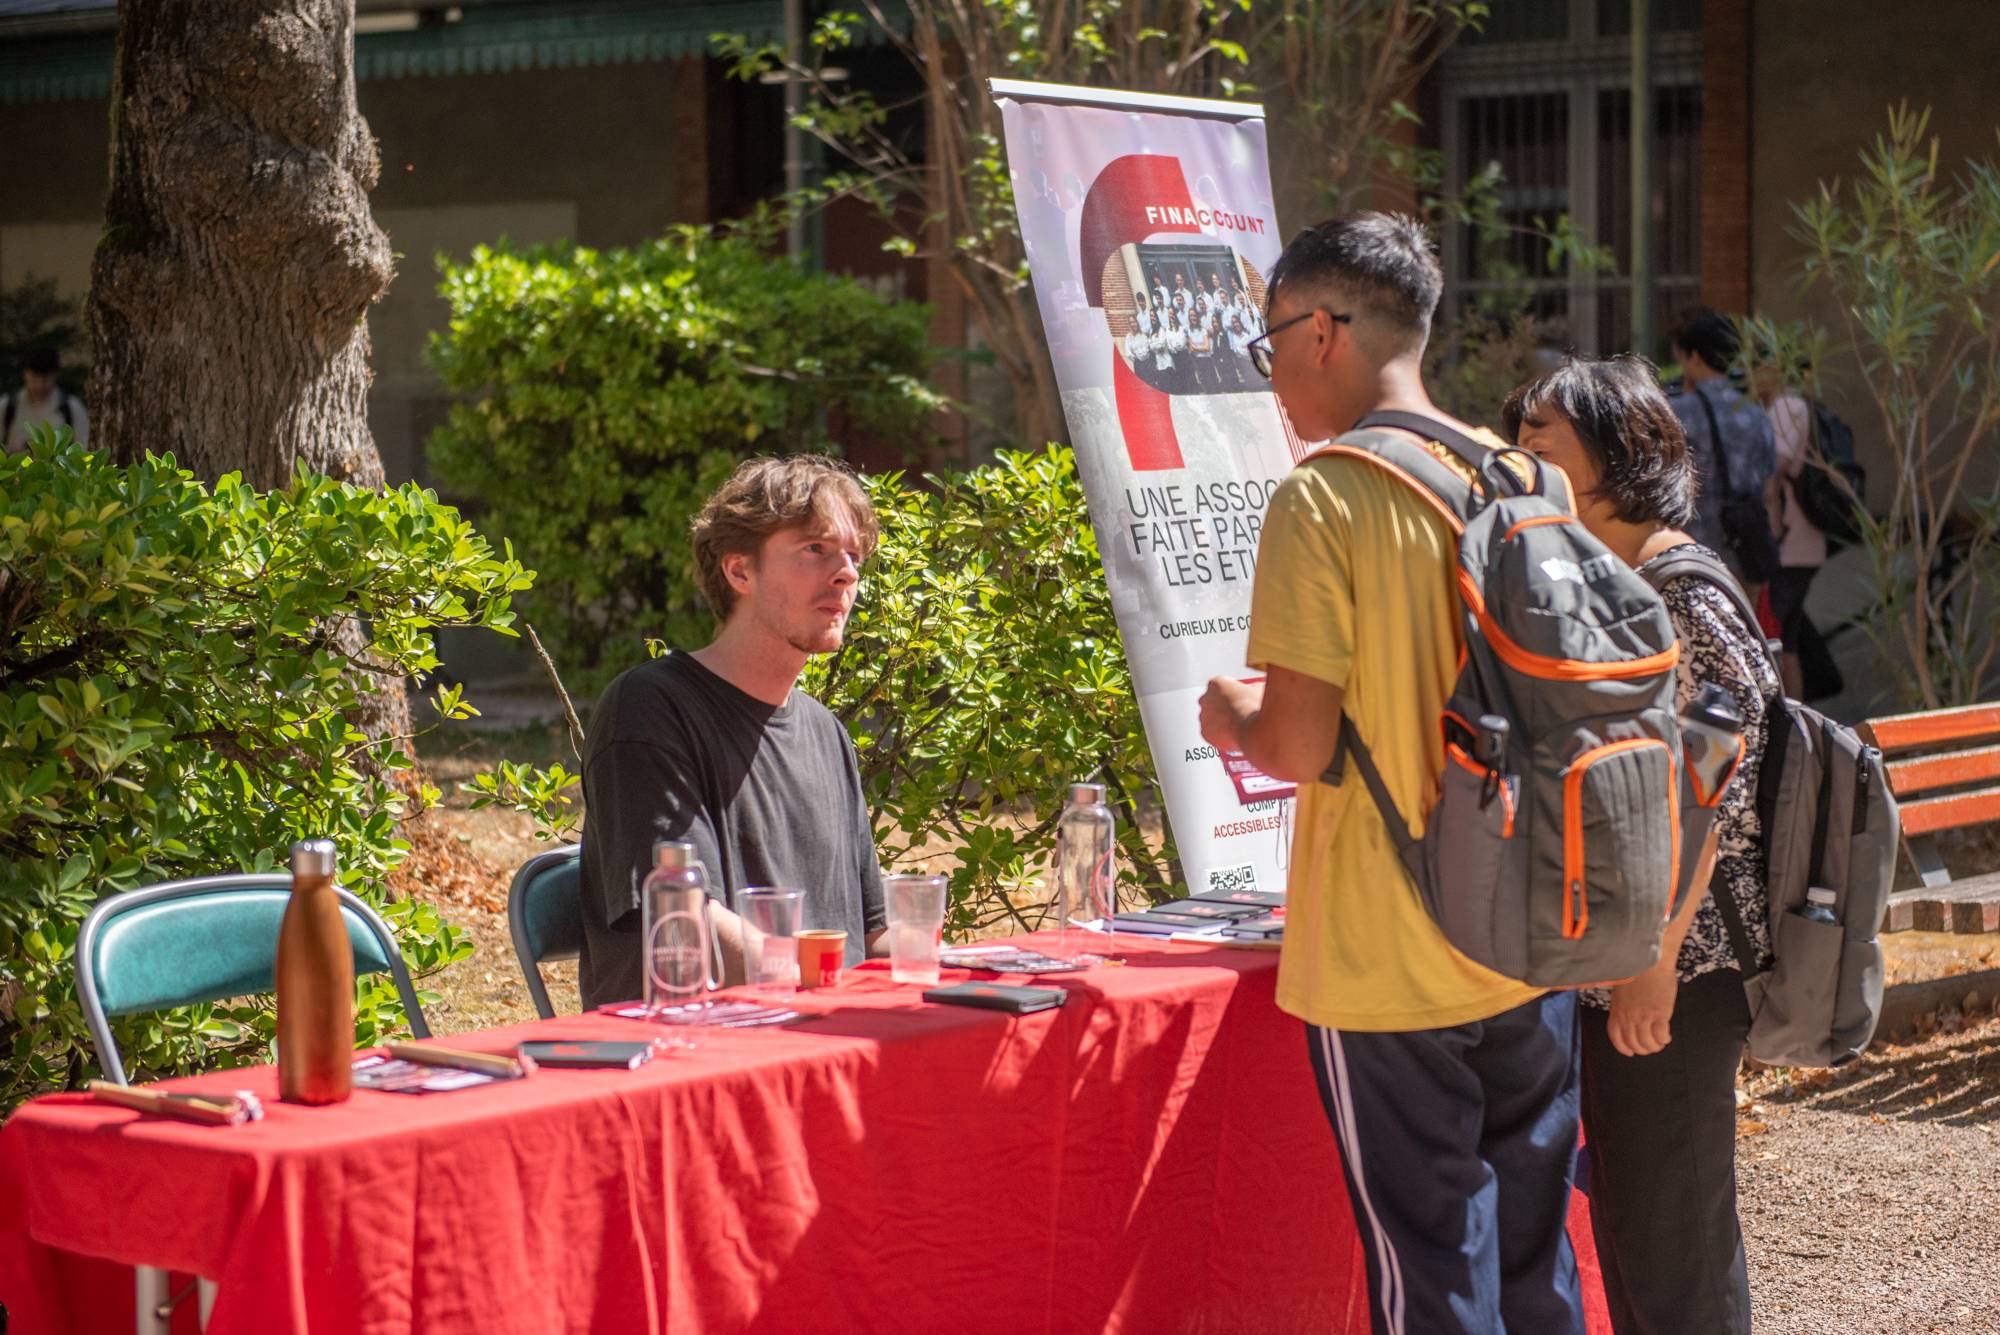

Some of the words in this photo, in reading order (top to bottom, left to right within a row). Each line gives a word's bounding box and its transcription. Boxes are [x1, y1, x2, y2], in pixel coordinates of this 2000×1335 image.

[1145, 206, 1265, 235] FINACCOUNT
[1125, 486, 1187, 518] UNE
[1196, 479, 1281, 514] ASSOC
[1130, 518, 1210, 554] FAITE
[1213, 515, 1262, 549] PAR
[1162, 553, 1212, 586] LES
[1160, 618, 1217, 639] CURIEUX
[1218, 617, 1235, 632] DE
[1214, 816, 1281, 839] ACCESSIBLES
